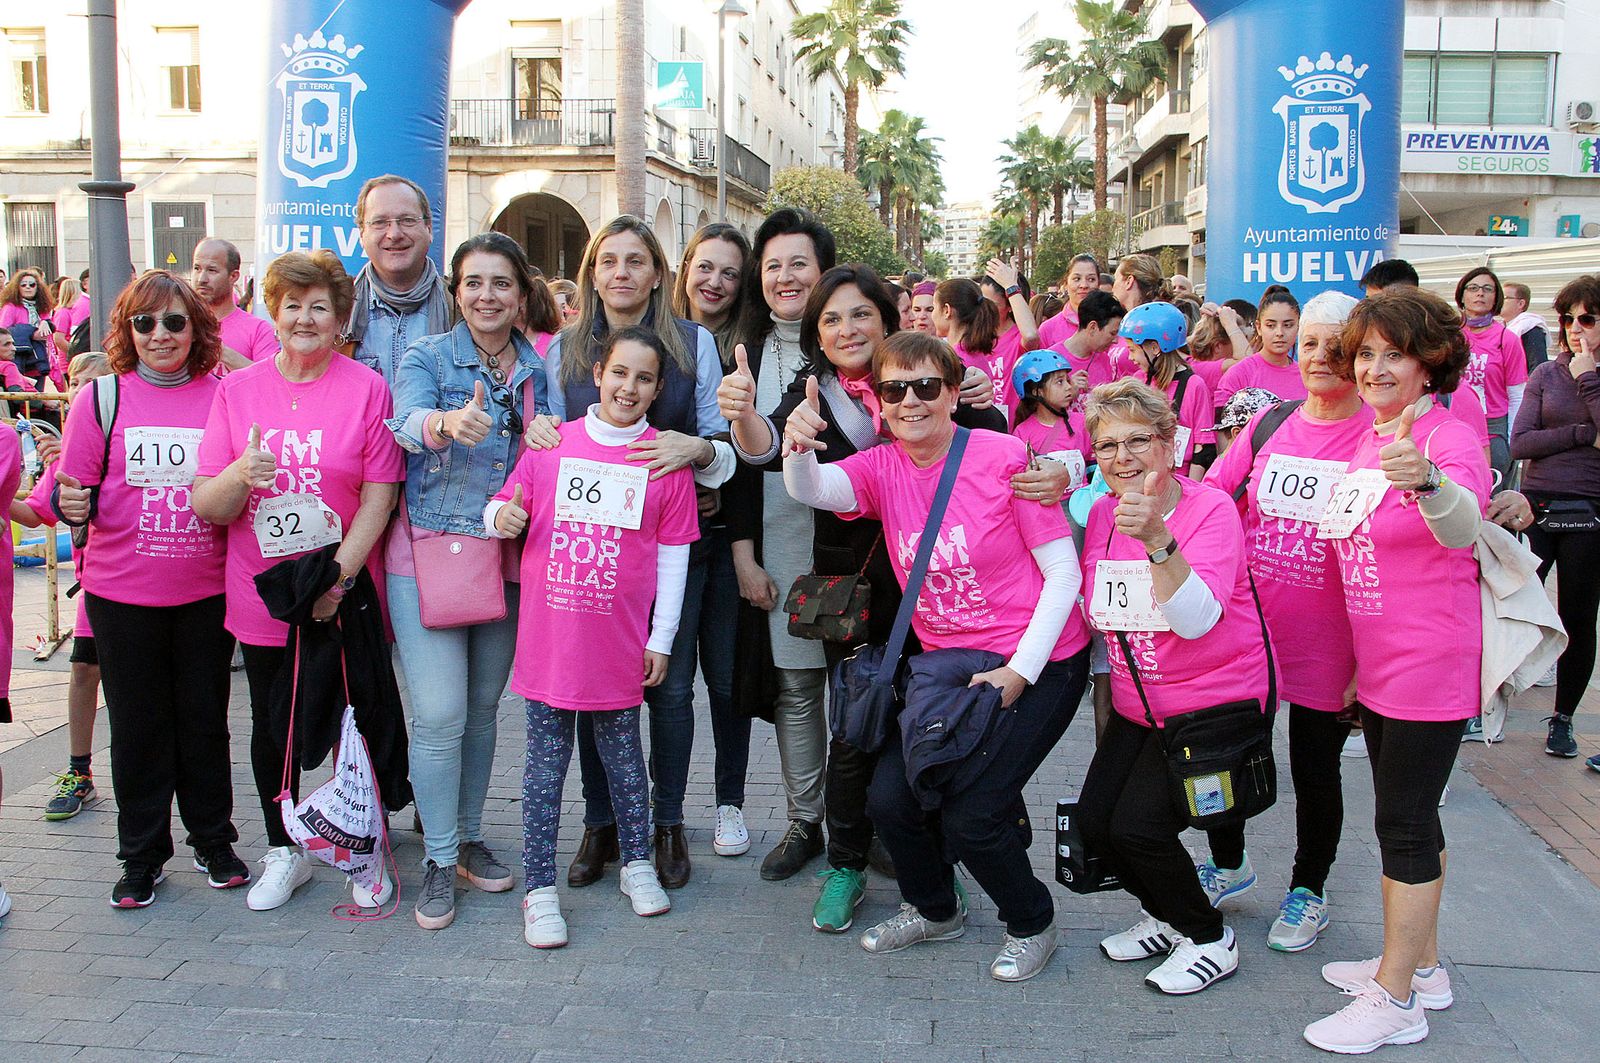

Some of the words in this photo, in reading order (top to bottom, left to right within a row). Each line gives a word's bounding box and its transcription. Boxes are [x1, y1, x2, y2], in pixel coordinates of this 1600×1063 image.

[298, 82, 308, 90] ET
[1304, 105, 1315, 114] ET
[339, 106, 348, 146] CUSTODIA
[1289, 120, 1297, 146] MARIS
[1406, 133, 1550, 151] PREVENTIVA
[1288, 149, 1296, 181] PORTUS
[1457, 156, 1550, 173] SEGUROS
[263, 199, 359, 219] yuntamiento
[1243, 225, 1370, 248] Ayuntamiento
[1373, 223, 1388, 240] de
[1491, 216, 1518, 235] 24h
[257, 224, 369, 258] HUELV
[129, 443, 185, 466] 410
[573, 463, 601, 475] Carrera
[602, 468, 612, 477] de
[623, 471, 643, 482] Mujer
[1311, 464, 1321, 472] de
[270, 467, 323, 495] OR
[567, 477, 602, 504] 86
[1268, 471, 1319, 500] 108
[142, 486, 193, 512] PO
[266, 512, 303, 538] 32
[1561, 521, 1595, 529] Kalenji
[146, 534, 175, 543] Carrera
[550, 531, 621, 570] POR
[898, 524, 970, 571] KM
[1255, 531, 1327, 563] ELLAS
[547, 561, 617, 590] ELLAS
[1124, 567, 1134, 576] de
[1135, 566, 1143, 575] la
[1257, 553, 1279, 565] Carrera
[1293, 562, 1301, 570] la
[1302, 564, 1326, 574] Mujer
[1342, 563, 1380, 588] LAS
[904, 566, 981, 594] OR
[552, 585, 574, 595] Carrera
[586, 590, 593, 598] la
[595, 592, 615, 601] Mujer
[1106, 581, 1129, 608] 13
[1362, 591, 1382, 600] Mujer
[950, 615, 960, 623] de
[1141, 672, 1163, 681] Mujer
